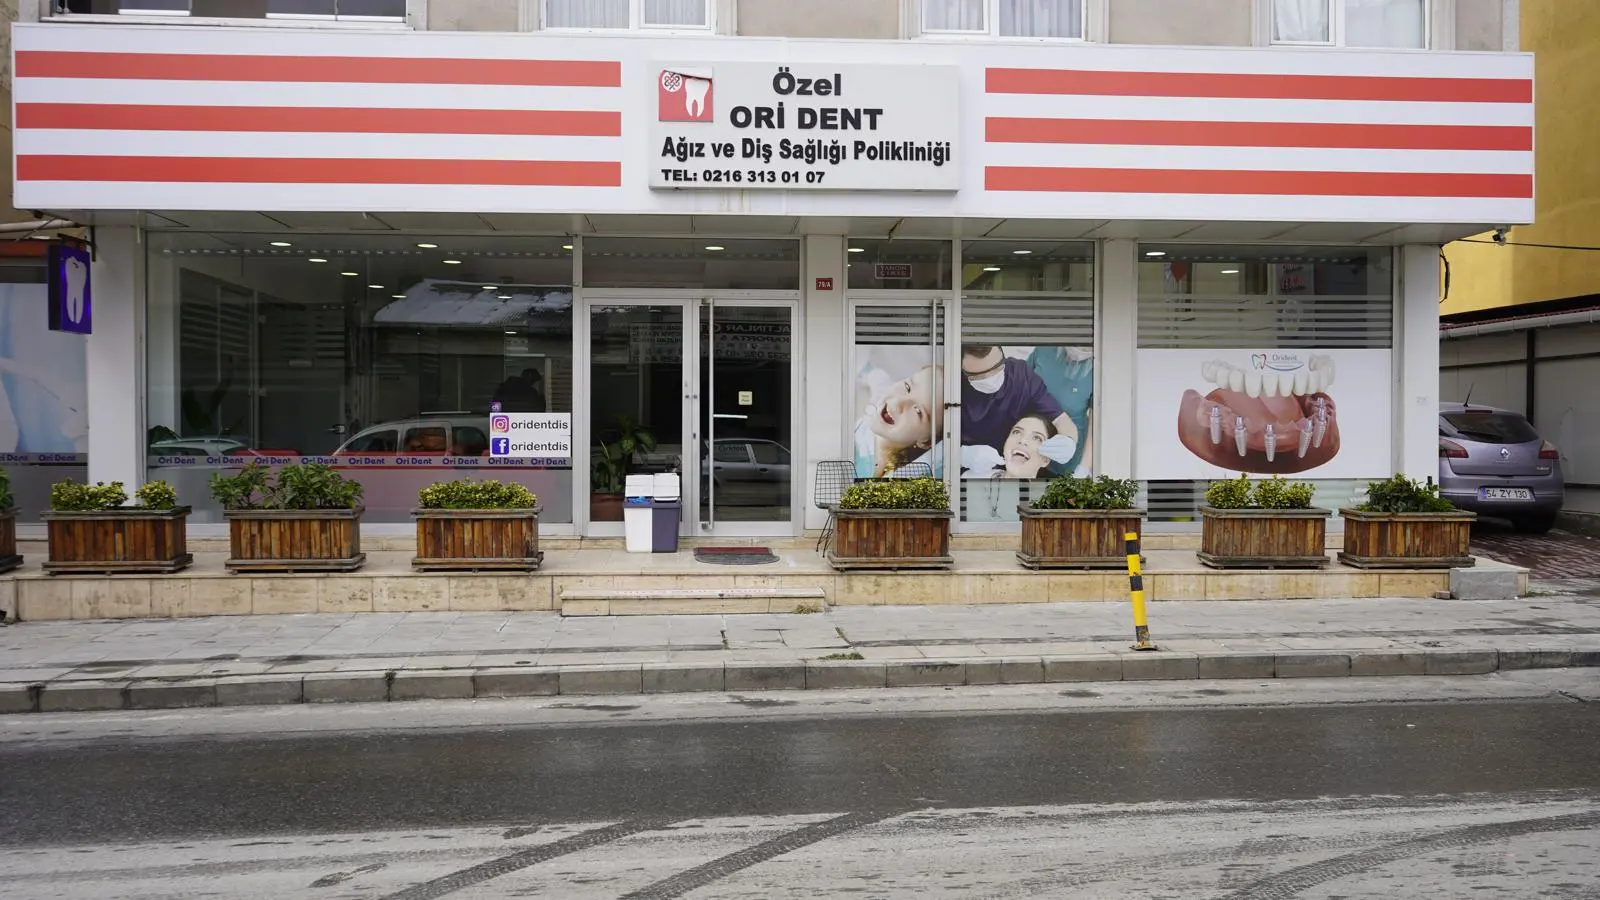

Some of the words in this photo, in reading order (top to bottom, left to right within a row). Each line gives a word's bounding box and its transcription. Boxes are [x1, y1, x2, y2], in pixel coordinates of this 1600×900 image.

[773, 67, 841, 96] Özel
[730, 102, 785, 129] ORİ
[797, 108, 883, 130] DENT
[661, 137, 705, 162] Ağız
[711, 142, 735, 158] ve
[742, 138, 773, 163] Diş
[779, 139, 847, 164] Sağlığı
[853, 140, 951, 166] Polikliniği
[661, 169, 698, 182] TEL:
[703, 170, 742, 182] 0216
[747, 170, 776, 183] 313
[781, 171, 803, 183] 01
[805, 171, 825, 183] 07
[511, 420, 569, 430] oridentdis
[511, 441, 569, 451] oridentdis
[1486, 489, 1496, 498] 54
[1500, 489, 1511, 498] ZY
[1515, 490, 1528, 498] 130
